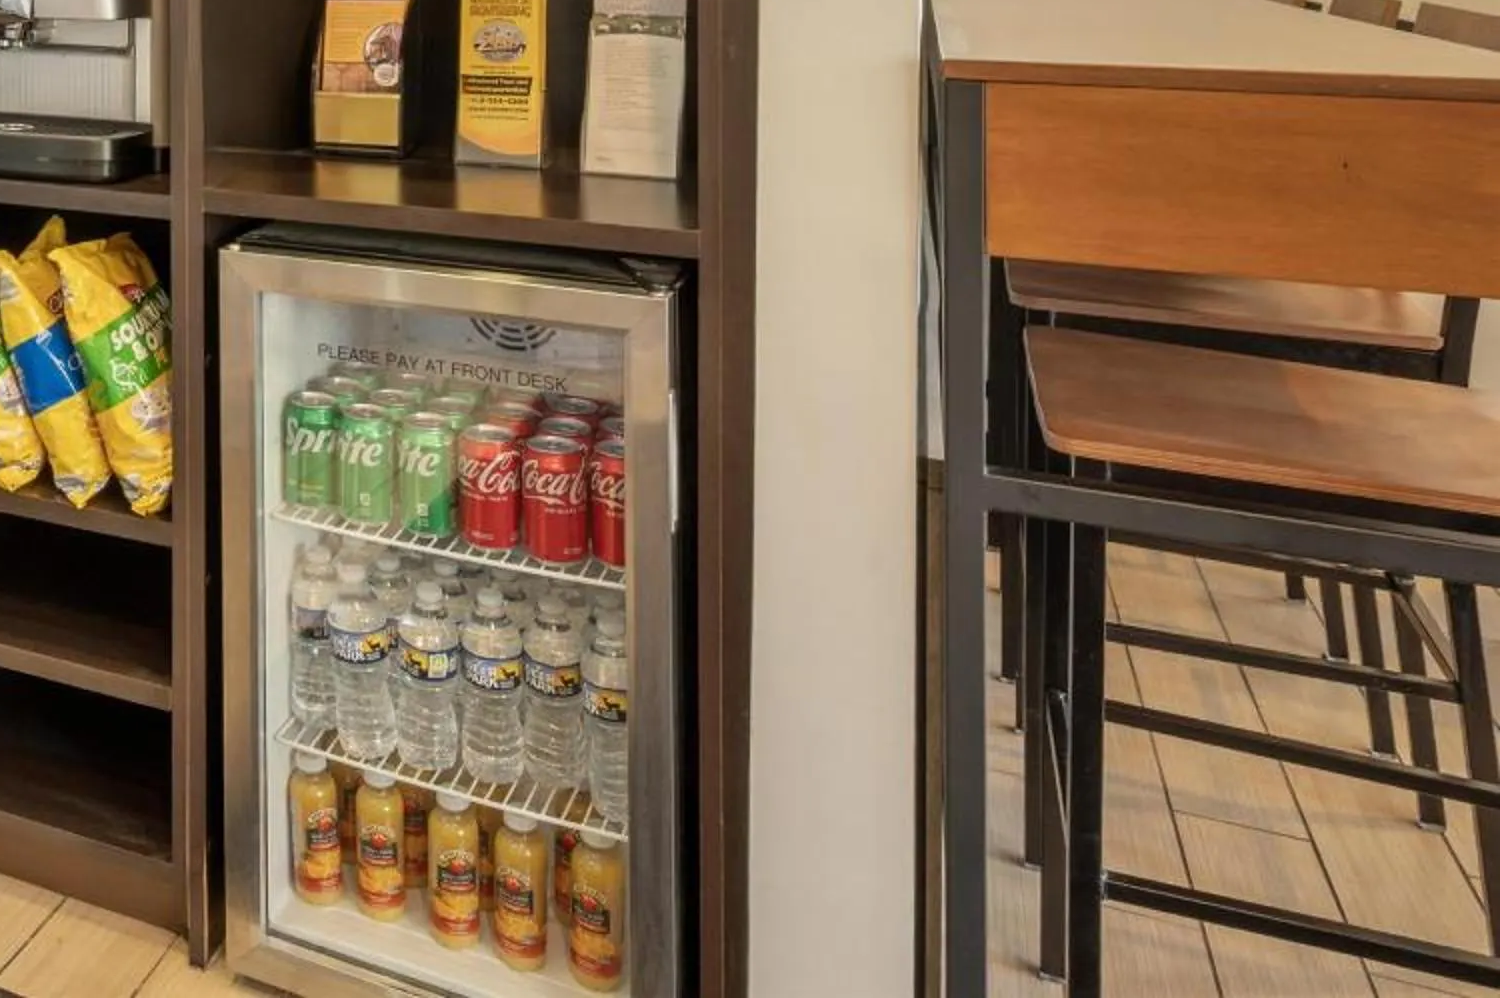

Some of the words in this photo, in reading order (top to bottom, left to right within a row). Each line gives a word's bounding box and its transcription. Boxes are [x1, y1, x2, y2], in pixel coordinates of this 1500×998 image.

[317, 343, 380, 364] PLEASE
[385, 352, 421, 370] PAY
[425, 359, 446, 375] AT
[451, 362, 513, 386] FRONT
[517, 372, 568, 392] DESK
[338, 431, 384, 467] ite
